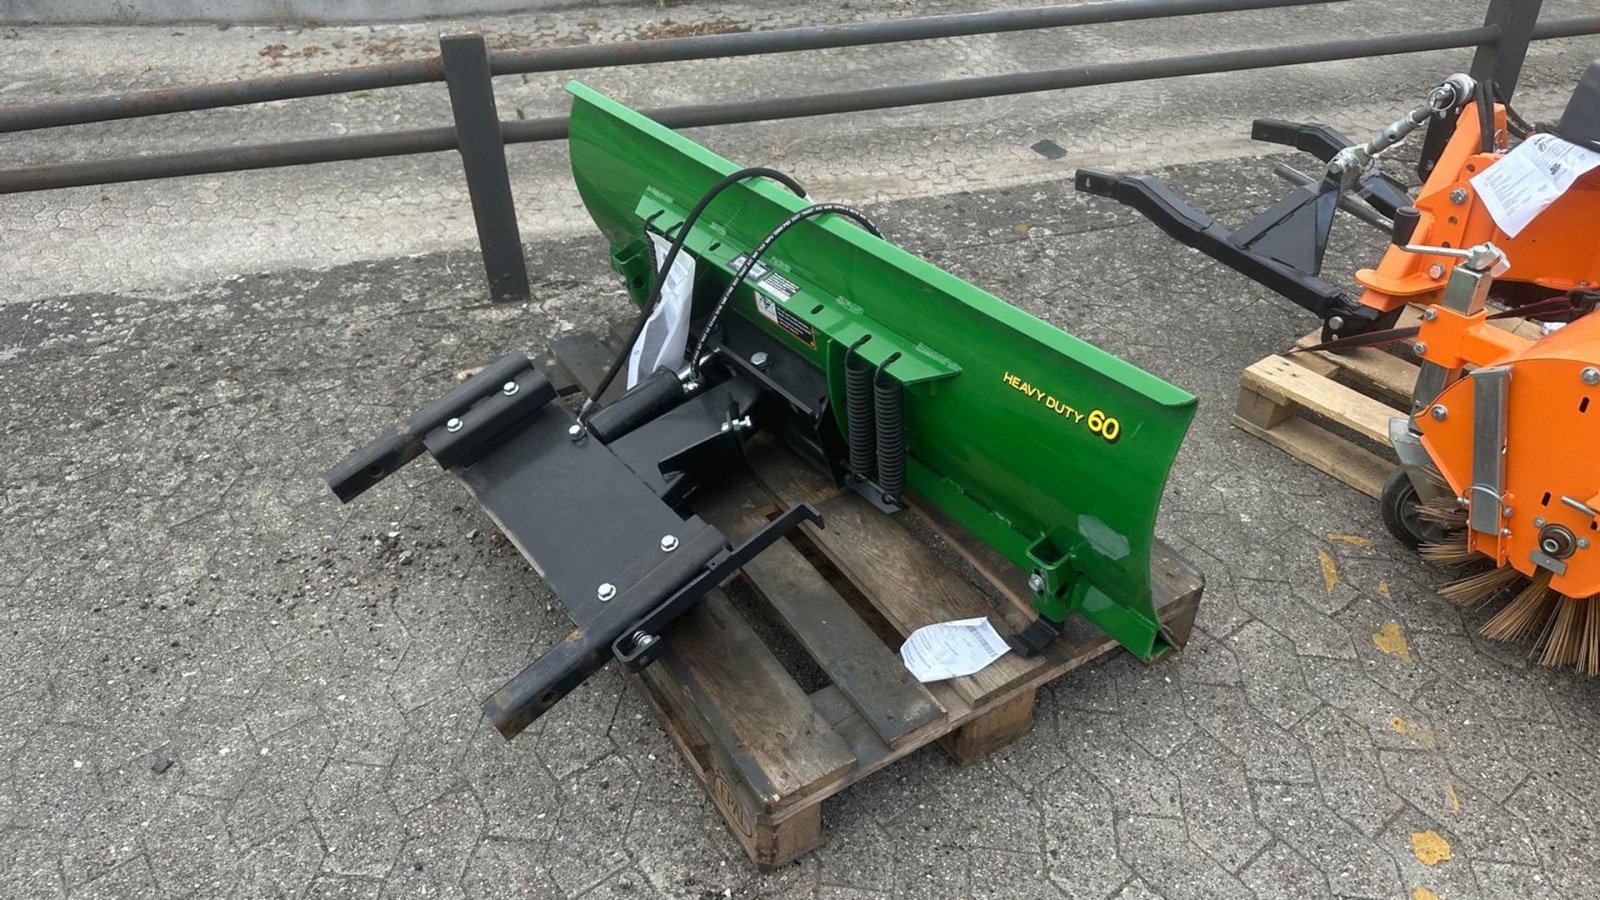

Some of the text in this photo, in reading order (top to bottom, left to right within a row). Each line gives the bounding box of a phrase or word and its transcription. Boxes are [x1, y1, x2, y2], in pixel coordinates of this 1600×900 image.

[1003, 372, 1120, 443] HEAVY DUTY 60
